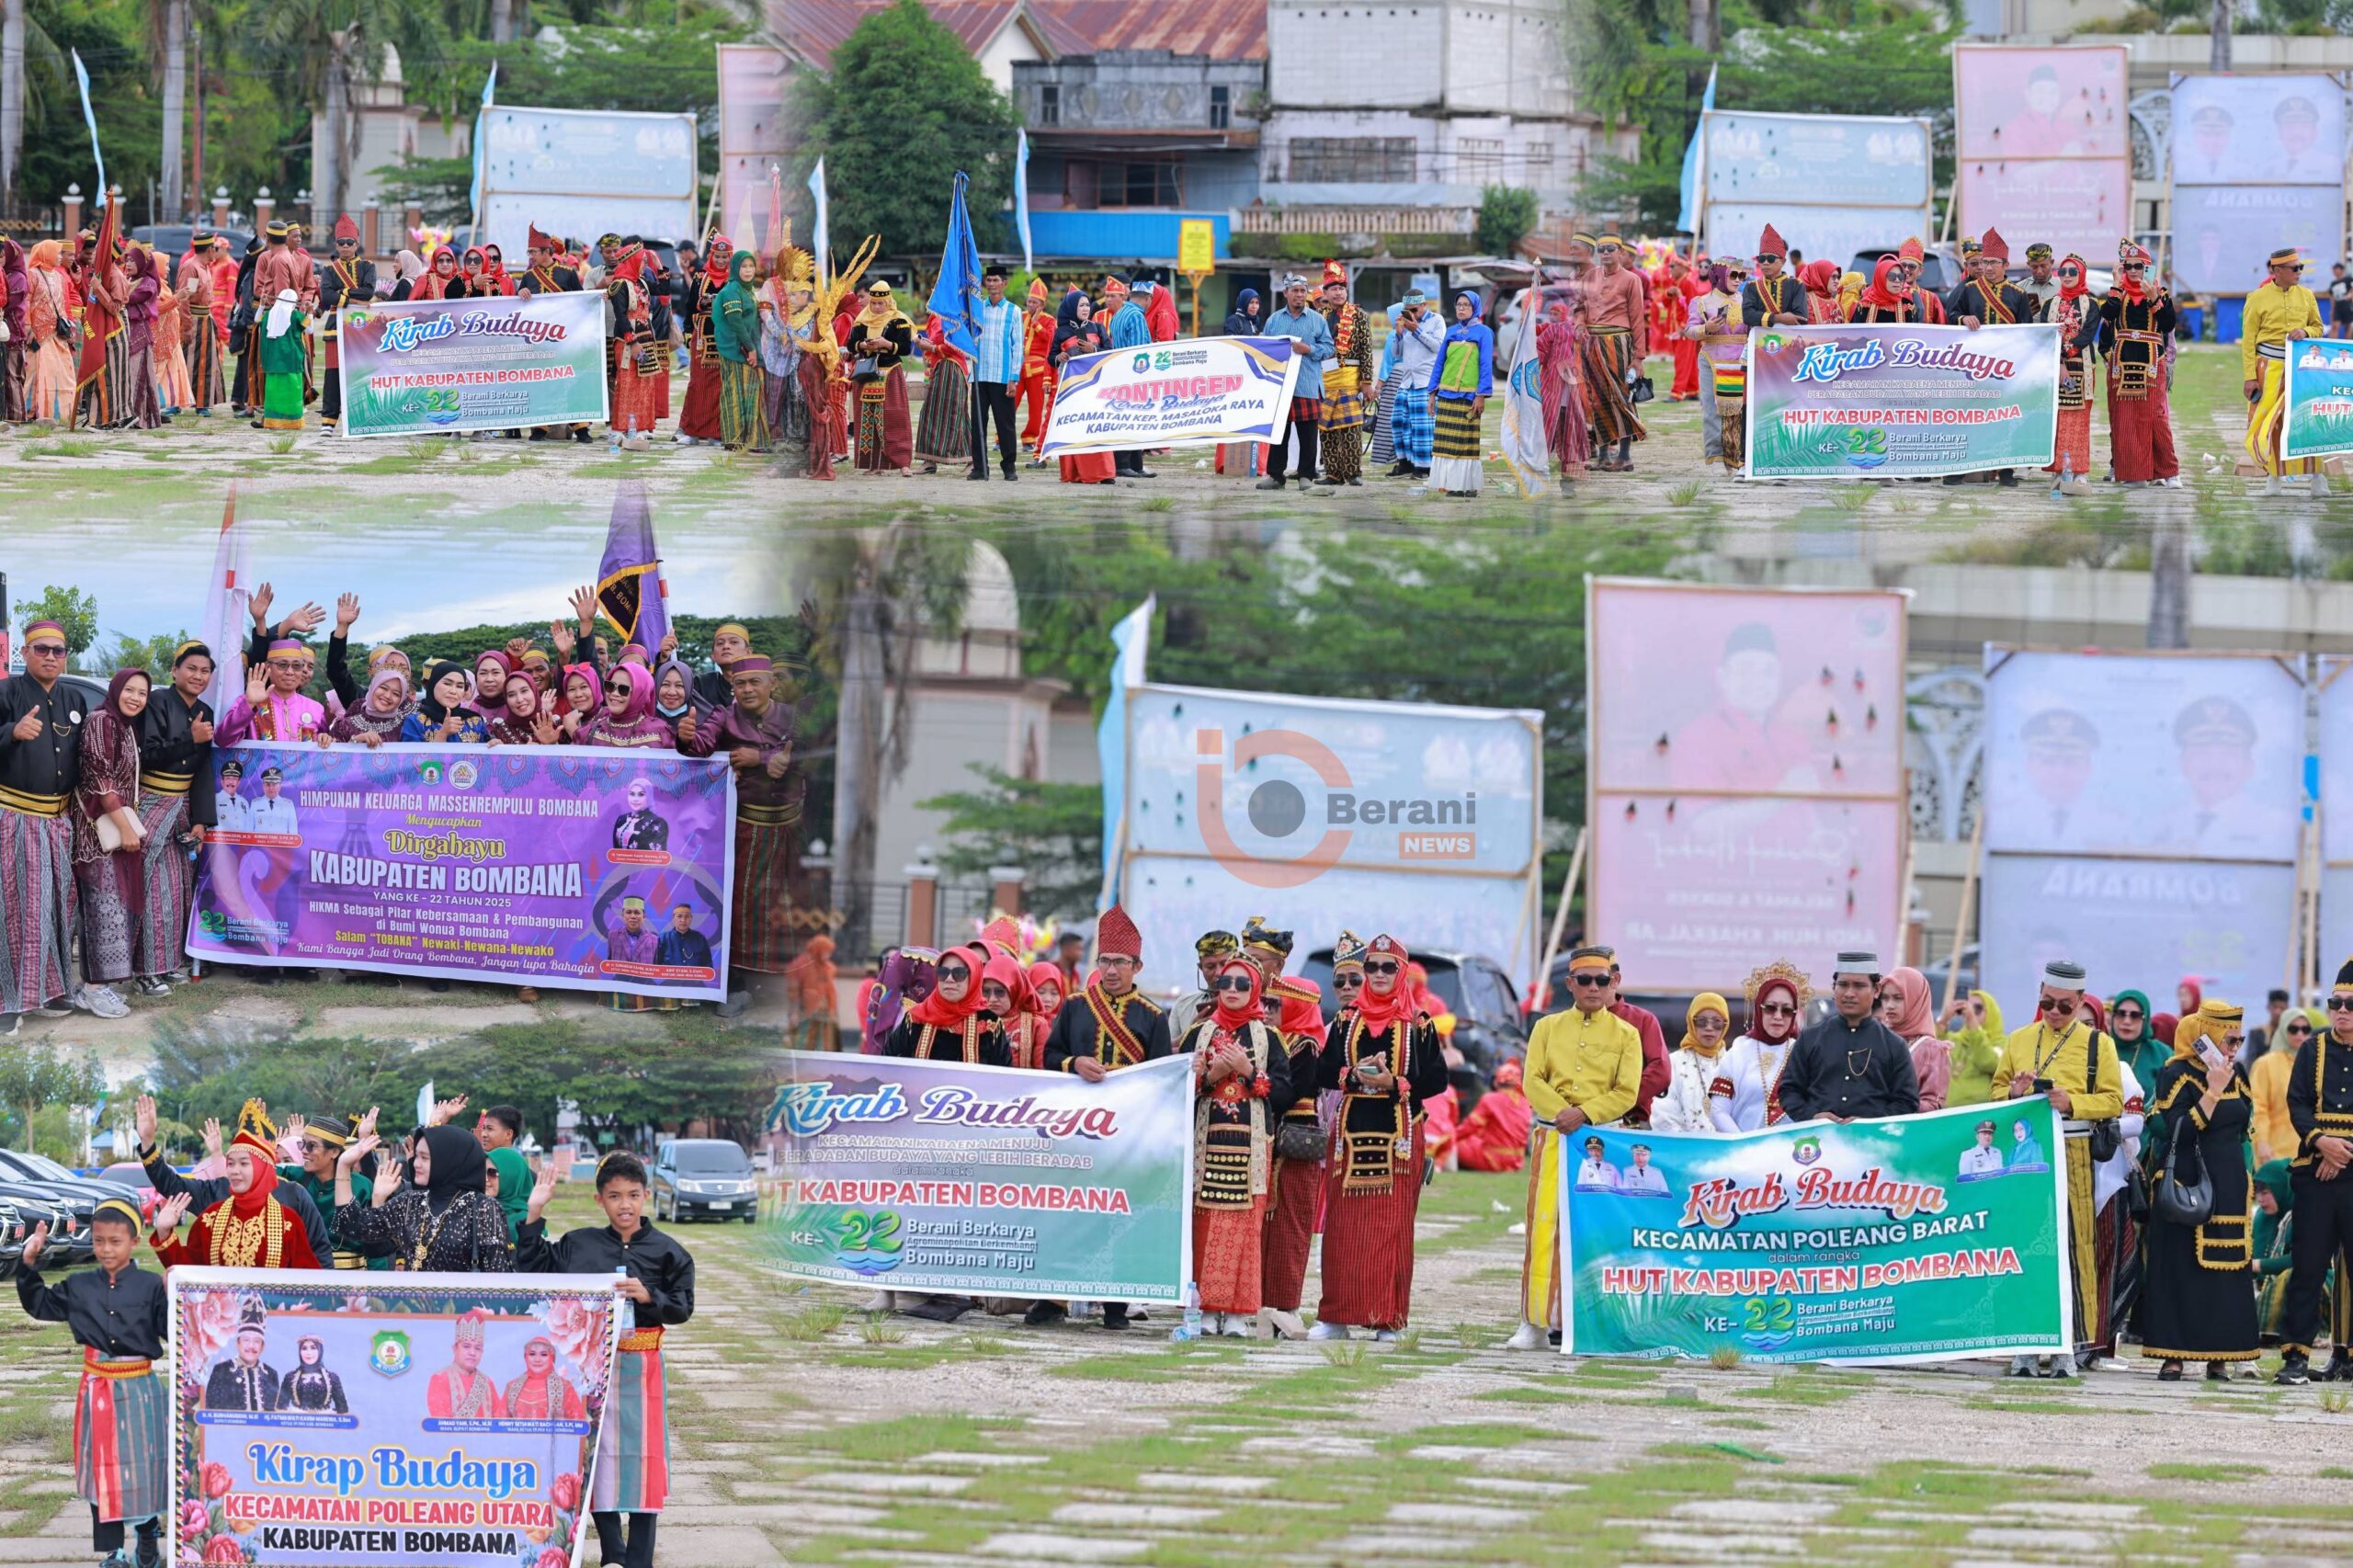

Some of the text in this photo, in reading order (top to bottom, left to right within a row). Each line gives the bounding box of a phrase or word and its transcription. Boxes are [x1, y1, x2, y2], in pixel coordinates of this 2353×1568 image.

[376, 310, 567, 353] Kirab Budaya
[1155, 350, 1171, 364] 22
[1792, 338, 2016, 382] Kirab Budaya
[371, 376, 401, 389] HUT
[404, 371, 494, 387] KABUPATEN
[497, 365, 574, 383] BOMBANA
[1097, 374, 1243, 403] KONTINGEN
[426, 389, 460, 412] 22
[462, 390, 529, 401] Berani Berkarya
[1159, 394, 1227, 412] Budaya
[1903, 390, 1931, 399] YANG
[1931, 390, 1957, 399] LEBIH
[1958, 390, 2001, 399] BERADAB
[462, 405, 529, 416] Bombana Maju
[1056, 399, 1265, 426] KECAMATAN KEP. MASALOKA RAYA
[1783, 404, 2021, 425] HUT KABUPATEN BOMBANA
[2312, 403, 2351, 416] HUT
[1086, 414, 1222, 434] KABUPATEN BOMBANA
[1818, 427, 1888, 454] KE- 22
[1889, 433, 1967, 444] Berani Berkarya
[1889, 450, 1967, 461] Bombana Maju
[300, 790, 598, 817] HIMPUNAN KELUARGA MASSENREMPULU BOMBANA
[405, 812, 483, 828] Mengucapkan
[383, 828, 506, 862] Dirgahayu
[309, 850, 583, 897] KABUPATEN BOMBANA
[373, 892, 404, 902] YANG
[405, 893, 419, 903] KE
[429, 894, 442, 903] 22
[445, 895, 483, 906] TAHUN
[484, 897, 512, 907] 2025
[199, 909, 226, 932] 22
[227, 916, 288, 929] Berani Berkarya
[310, 901, 584, 930] HIKMA Sebagai Pilar Kebersamaan & Pembangunan
[228, 931, 288, 945] Bombana Maju
[376, 920, 509, 939] di Bumi Wonua Bombana
[335, 930, 366, 943] Salam
[422, 936, 554, 957] Newaki-Newana-Newako
[296, 942, 323, 954] Kami
[326, 943, 364, 959] Bangga
[368, 946, 390, 959] Jadi
[392, 948, 424, 963] Orang
[426, 950, 477, 965] Bombana,
[481, 955, 520, 970] Jangan
[522, 958, 547, 974] lupa
[550, 960, 595, 974] Bahagia
[762, 1082, 1119, 1139] Kirab Budaya
[818, 1134, 1052, 1151] KECAMATAN KABAENA MENUJU
[777, 1149, 1094, 1169] PERADABAN BUDAYA YANG LEBIH BERADAB
[893, 1165, 974, 1178] dalam rangka
[746, 1179, 1131, 1215] UT KABUPATEN BOMBANA
[1678, 1165, 1948, 1229] Kirab Budaya
[791, 1209, 904, 1253] KE- 22
[907, 1219, 1036, 1241] Berani Berkarya
[1631, 1210, 1989, 1251] KECAMATAN POLEANG BARAT
[905, 1250, 1036, 1273] Bombana Maju
[1768, 1250, 1860, 1265] dalam rangka
[1602, 1246, 2024, 1298] HUT KABUPATEN BOMBANA
[1704, 1297, 1795, 1332] KE- 22
[1797, 1296, 1893, 1315] Berani Berkarya
[1796, 1318, 1895, 1337] Bombana Maju
[246, 1441, 539, 1500] Kirap Budaya
[223, 1492, 558, 1530] KECAMATAN POLEANG UTARA
[261, 1526, 518, 1555] KABUPATEN BOMBANA
